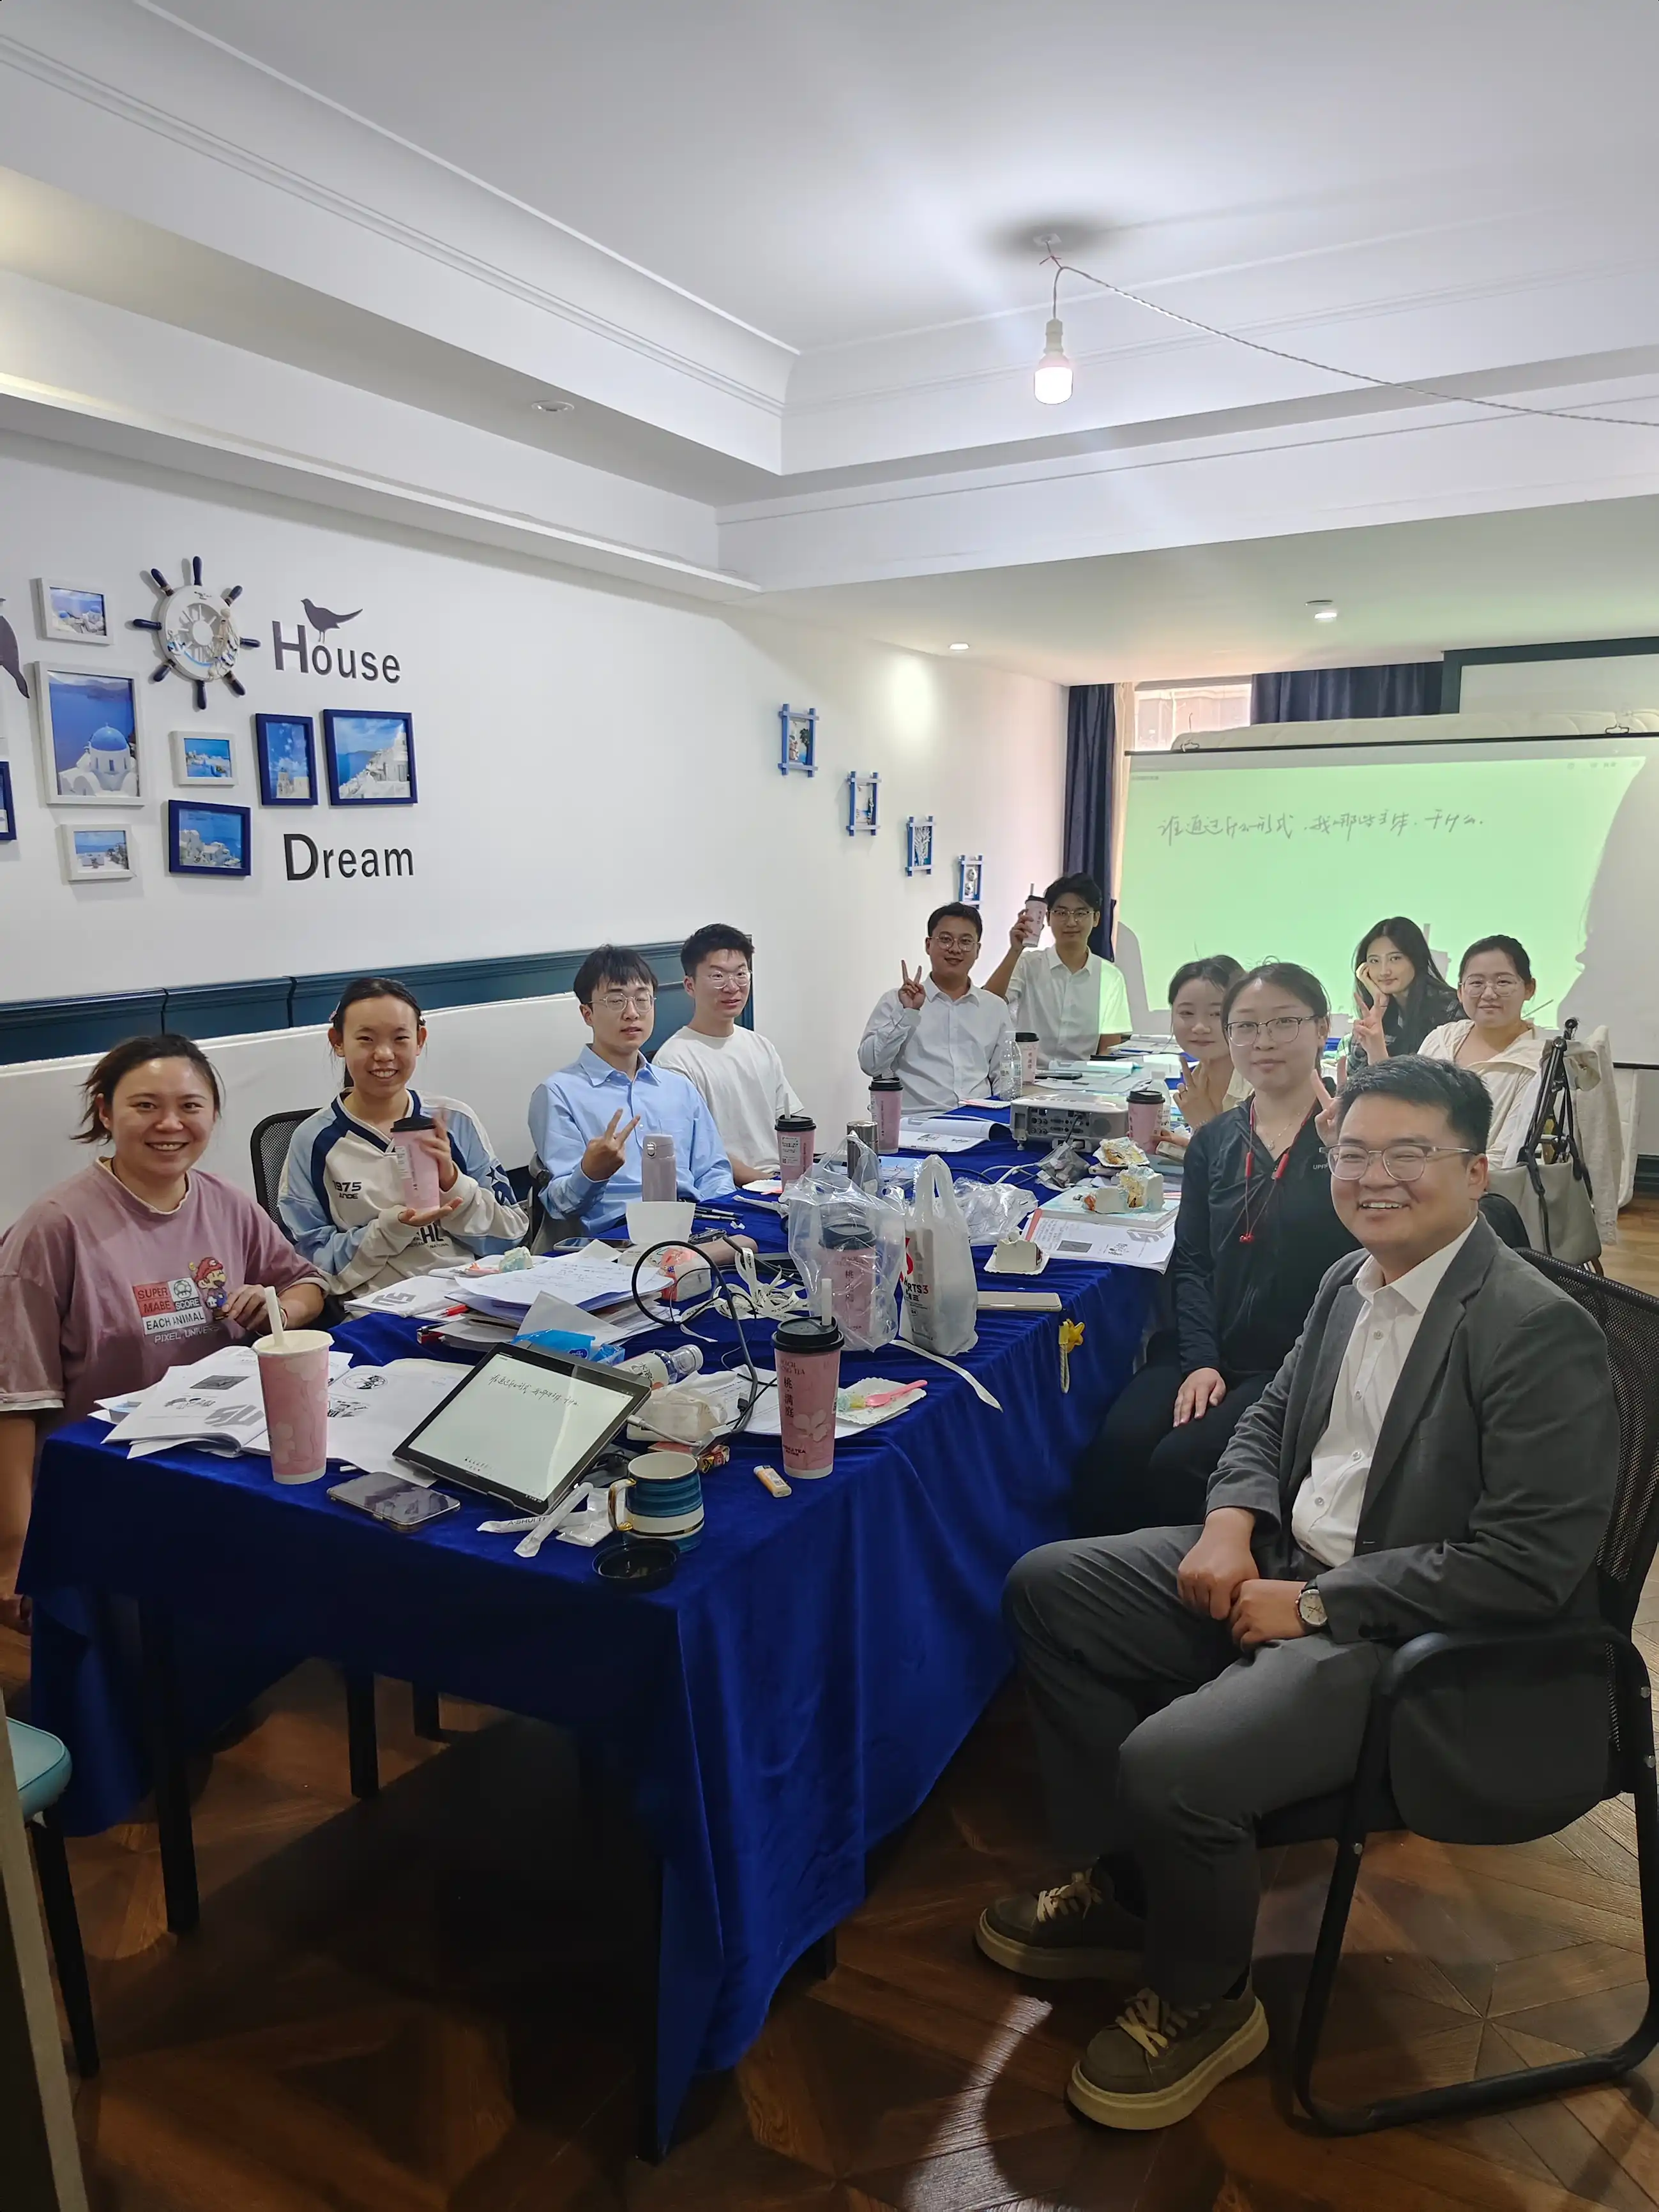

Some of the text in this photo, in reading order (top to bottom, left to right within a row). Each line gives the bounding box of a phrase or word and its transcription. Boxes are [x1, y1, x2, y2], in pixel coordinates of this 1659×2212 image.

[272, 620, 401, 684] House
[284, 833, 414, 881] Dream
[138, 1287, 168, 1299] SUPER
[143, 1300, 171, 1313] MABE
[176, 1299, 201, 1310] SCORE
[146, 1312, 204, 1330] EACH ANIMAL
[155, 1332, 181, 1344] PIXEL
